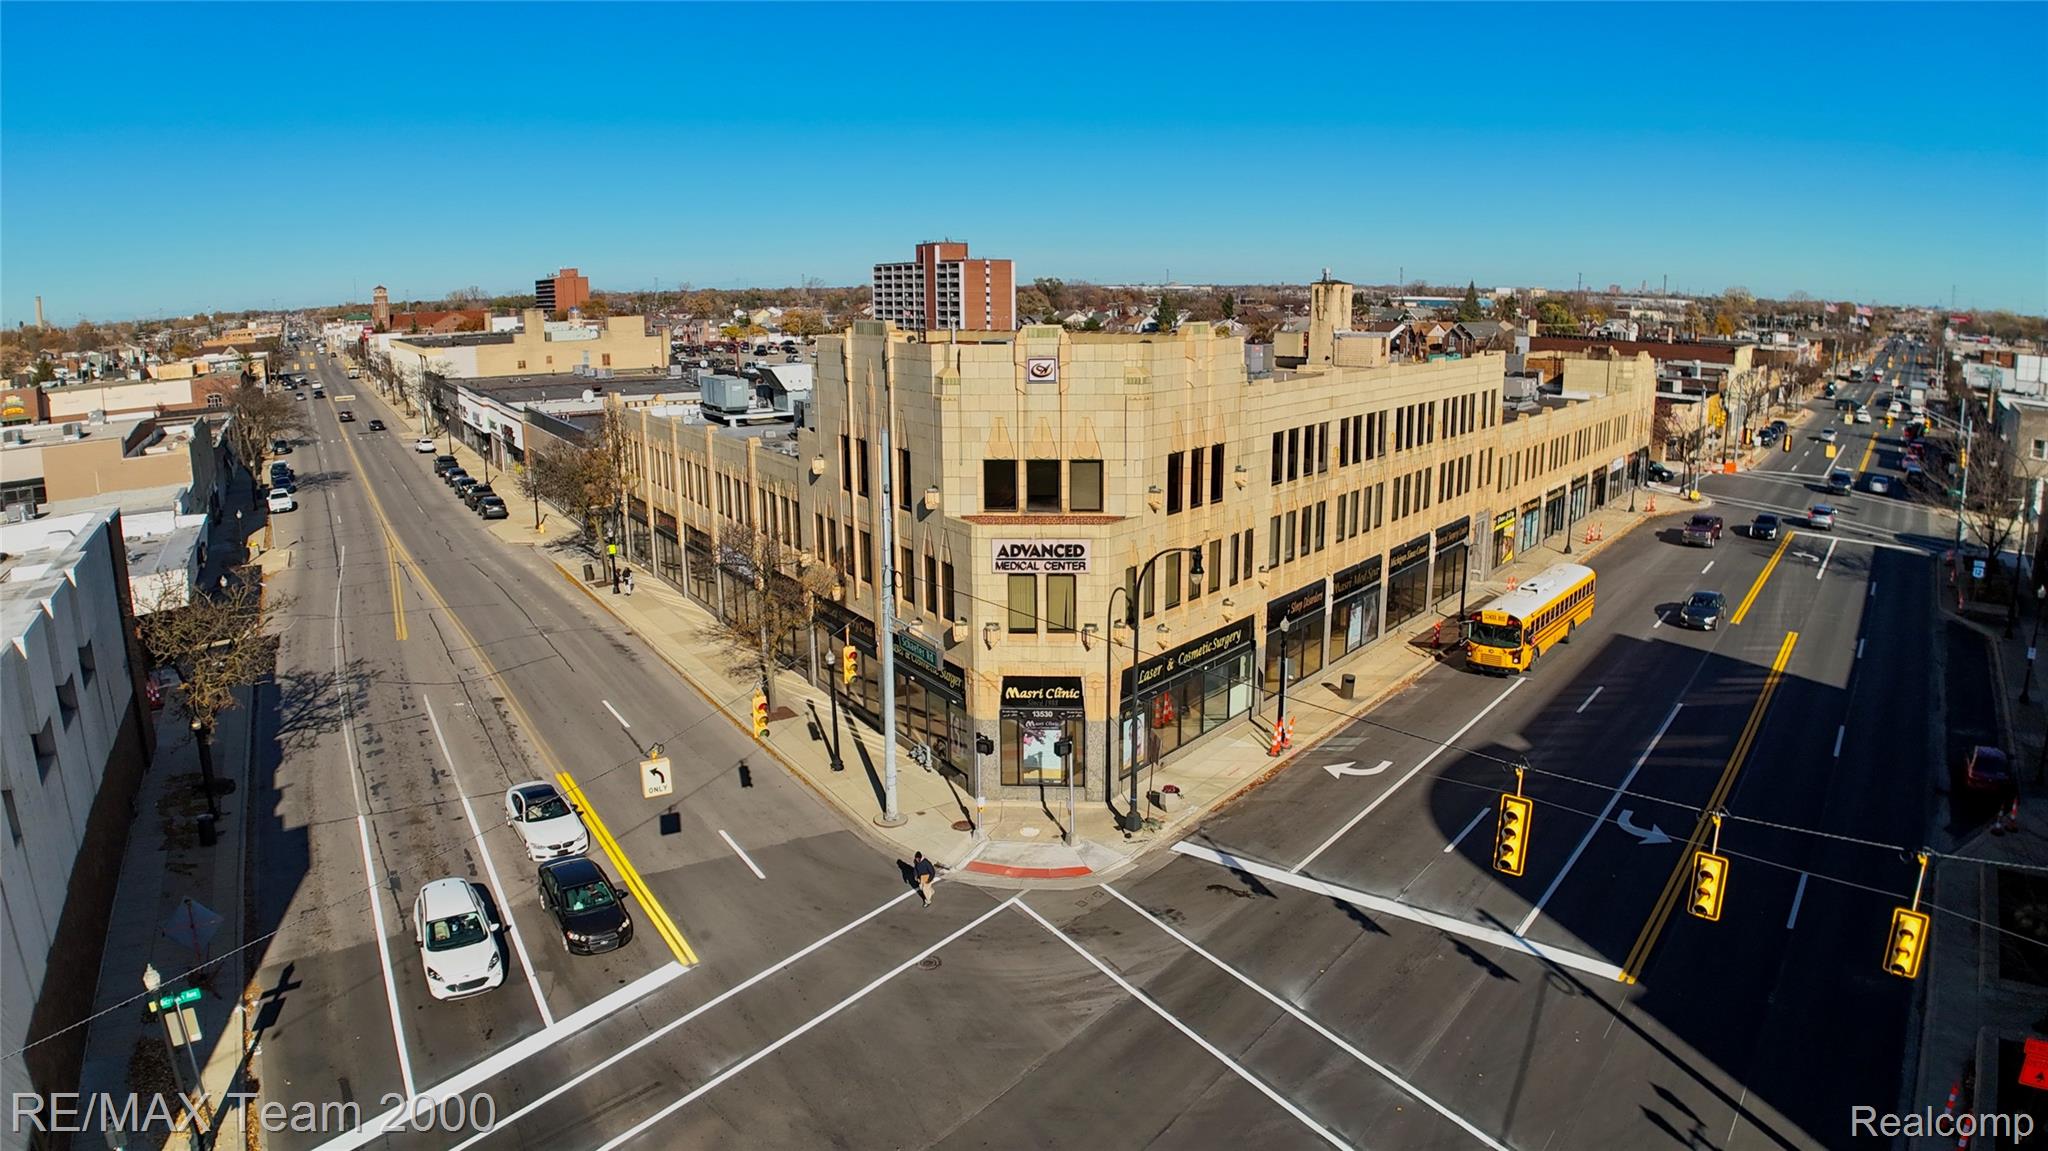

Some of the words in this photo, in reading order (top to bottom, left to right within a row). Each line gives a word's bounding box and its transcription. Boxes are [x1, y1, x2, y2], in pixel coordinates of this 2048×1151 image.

[997, 543, 1085, 558] ADVANCED
[995, 560, 1040, 571] MEDICAL
[1043, 560, 1087, 571] CENTER
[1137, 664, 1163, 685] Laser
[1166, 658, 1175, 672] &
[1178, 640, 1213, 666] Cosmetic
[1211, 629, 1242, 651] Surgery
[1005, 686, 1044, 700] Masri
[1045, 686, 1080, 699] Clinic
[1032, 710, 1054, 718] 13530
[648, 783, 668, 794] ONLY
